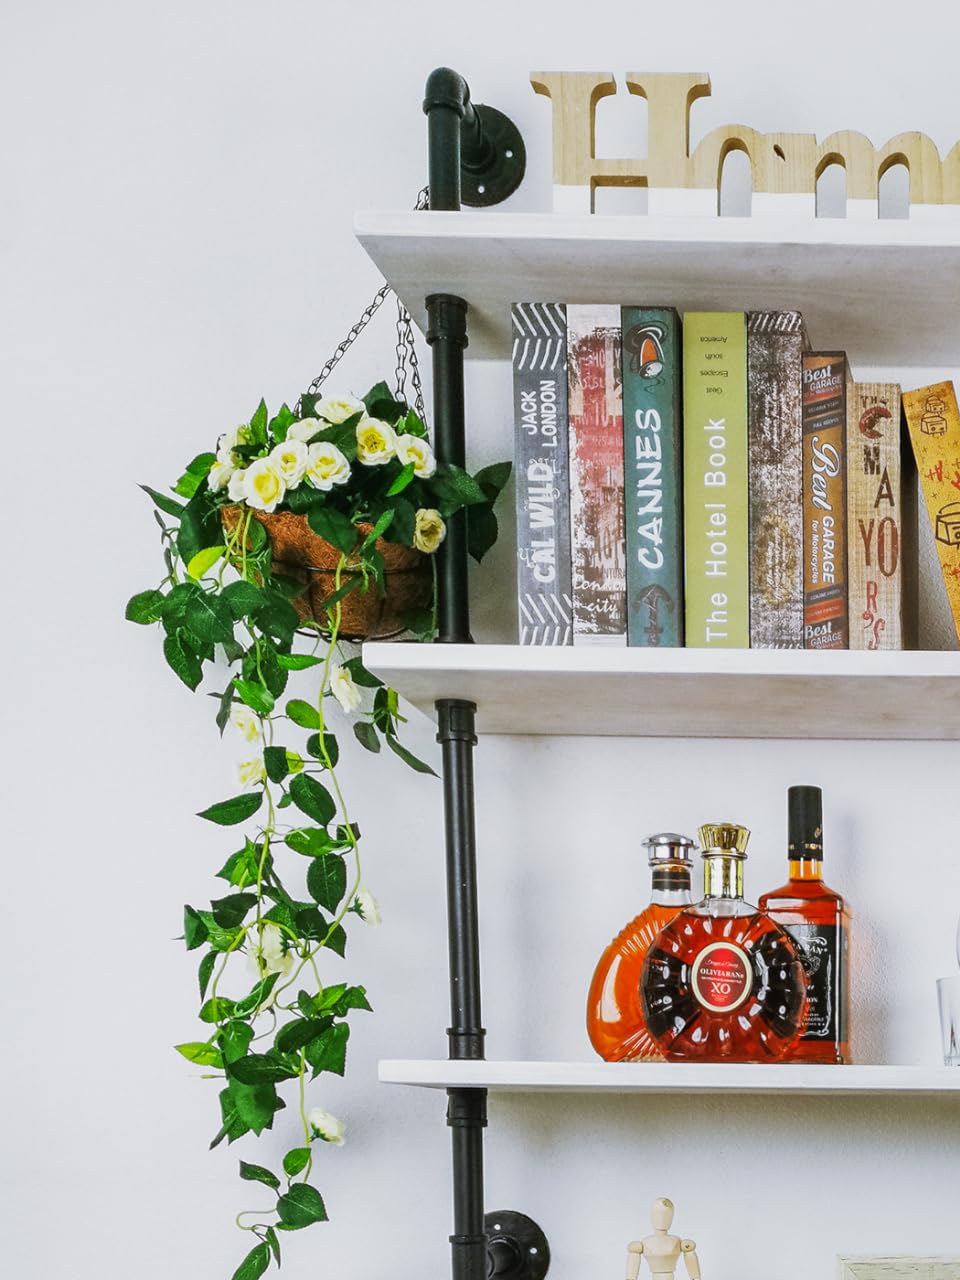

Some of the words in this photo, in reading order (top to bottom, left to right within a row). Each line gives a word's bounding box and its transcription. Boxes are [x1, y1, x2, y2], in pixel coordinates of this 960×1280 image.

[700, 369, 729, 378] Escapes
[803, 364, 833, 384] Best
[809, 375, 842, 392] GARAGE
[520, 390, 538, 436] JACK
[540, 380, 557, 447] LONDON
[703, 417, 727, 487] Book
[811, 435, 841, 513] Best
[527, 462, 555, 529] WILD
[635, 408, 664, 570] CANNES
[704, 503, 728, 577] Hotel
[811, 519, 820, 533] for
[532, 538, 556, 584] CAL
[822, 515, 835, 585] GARAGE
[705, 591, 728, 643] The
[804, 621, 833, 640] Best
[810, 632, 843, 648] GARAGE
[710, 982, 731, 995] XO
